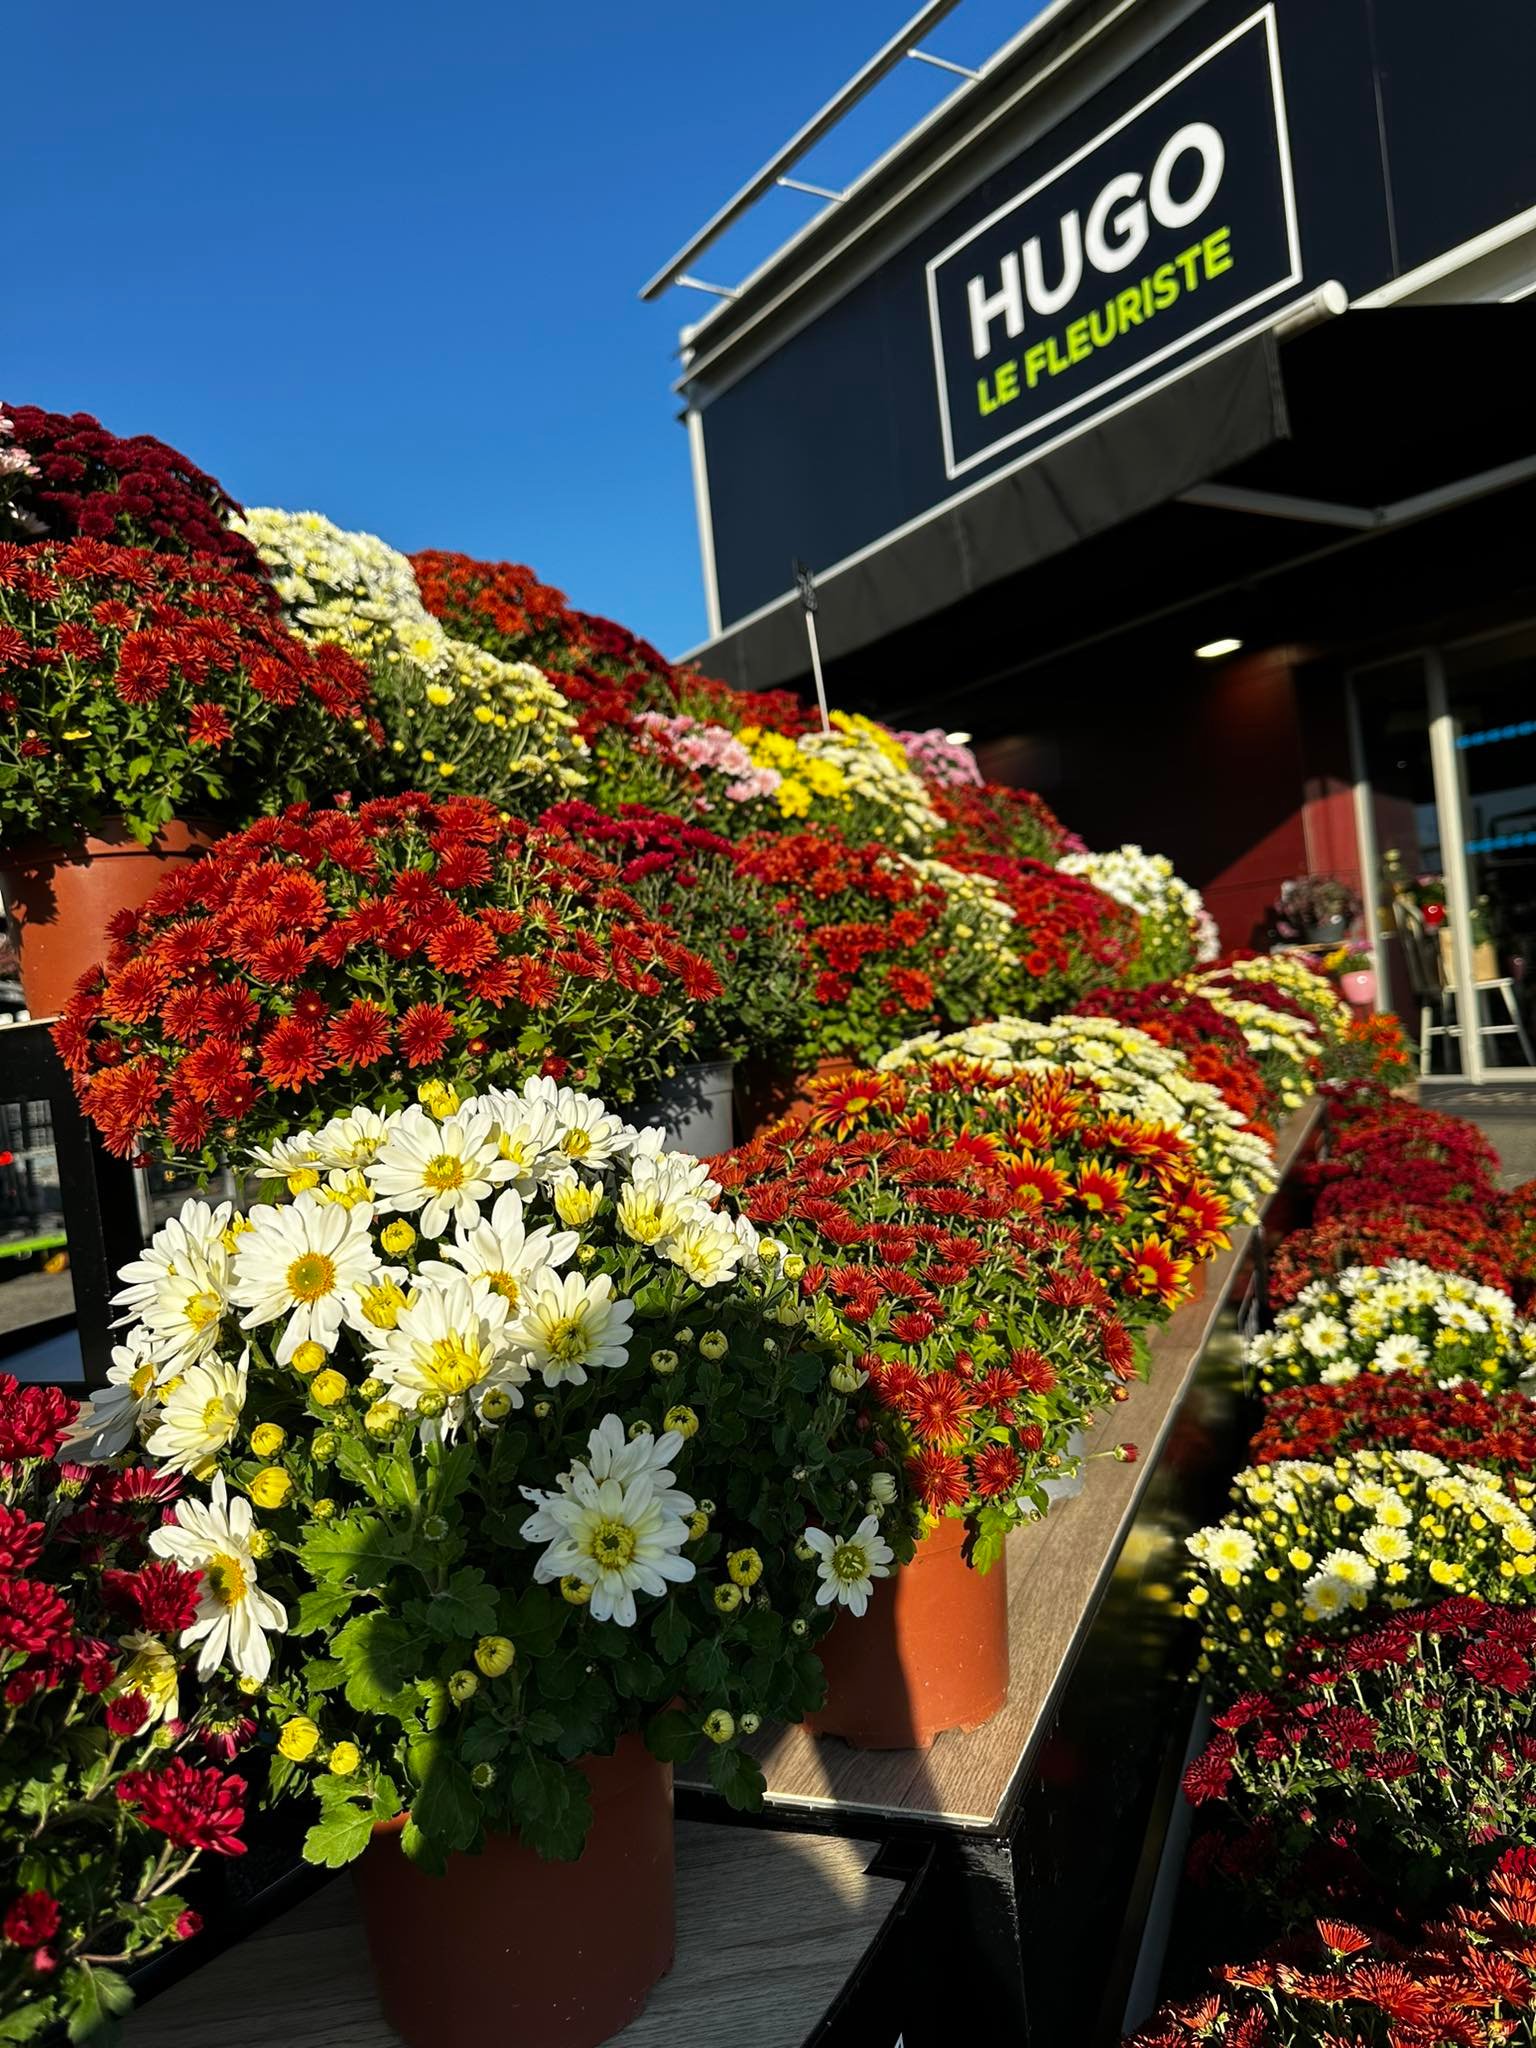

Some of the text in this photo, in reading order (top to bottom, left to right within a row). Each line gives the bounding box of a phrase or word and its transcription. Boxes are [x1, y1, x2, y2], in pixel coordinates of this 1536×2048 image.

[967, 122, 1225, 360] HUGO
[976, 226, 1234, 416] LE FLEURISTE
